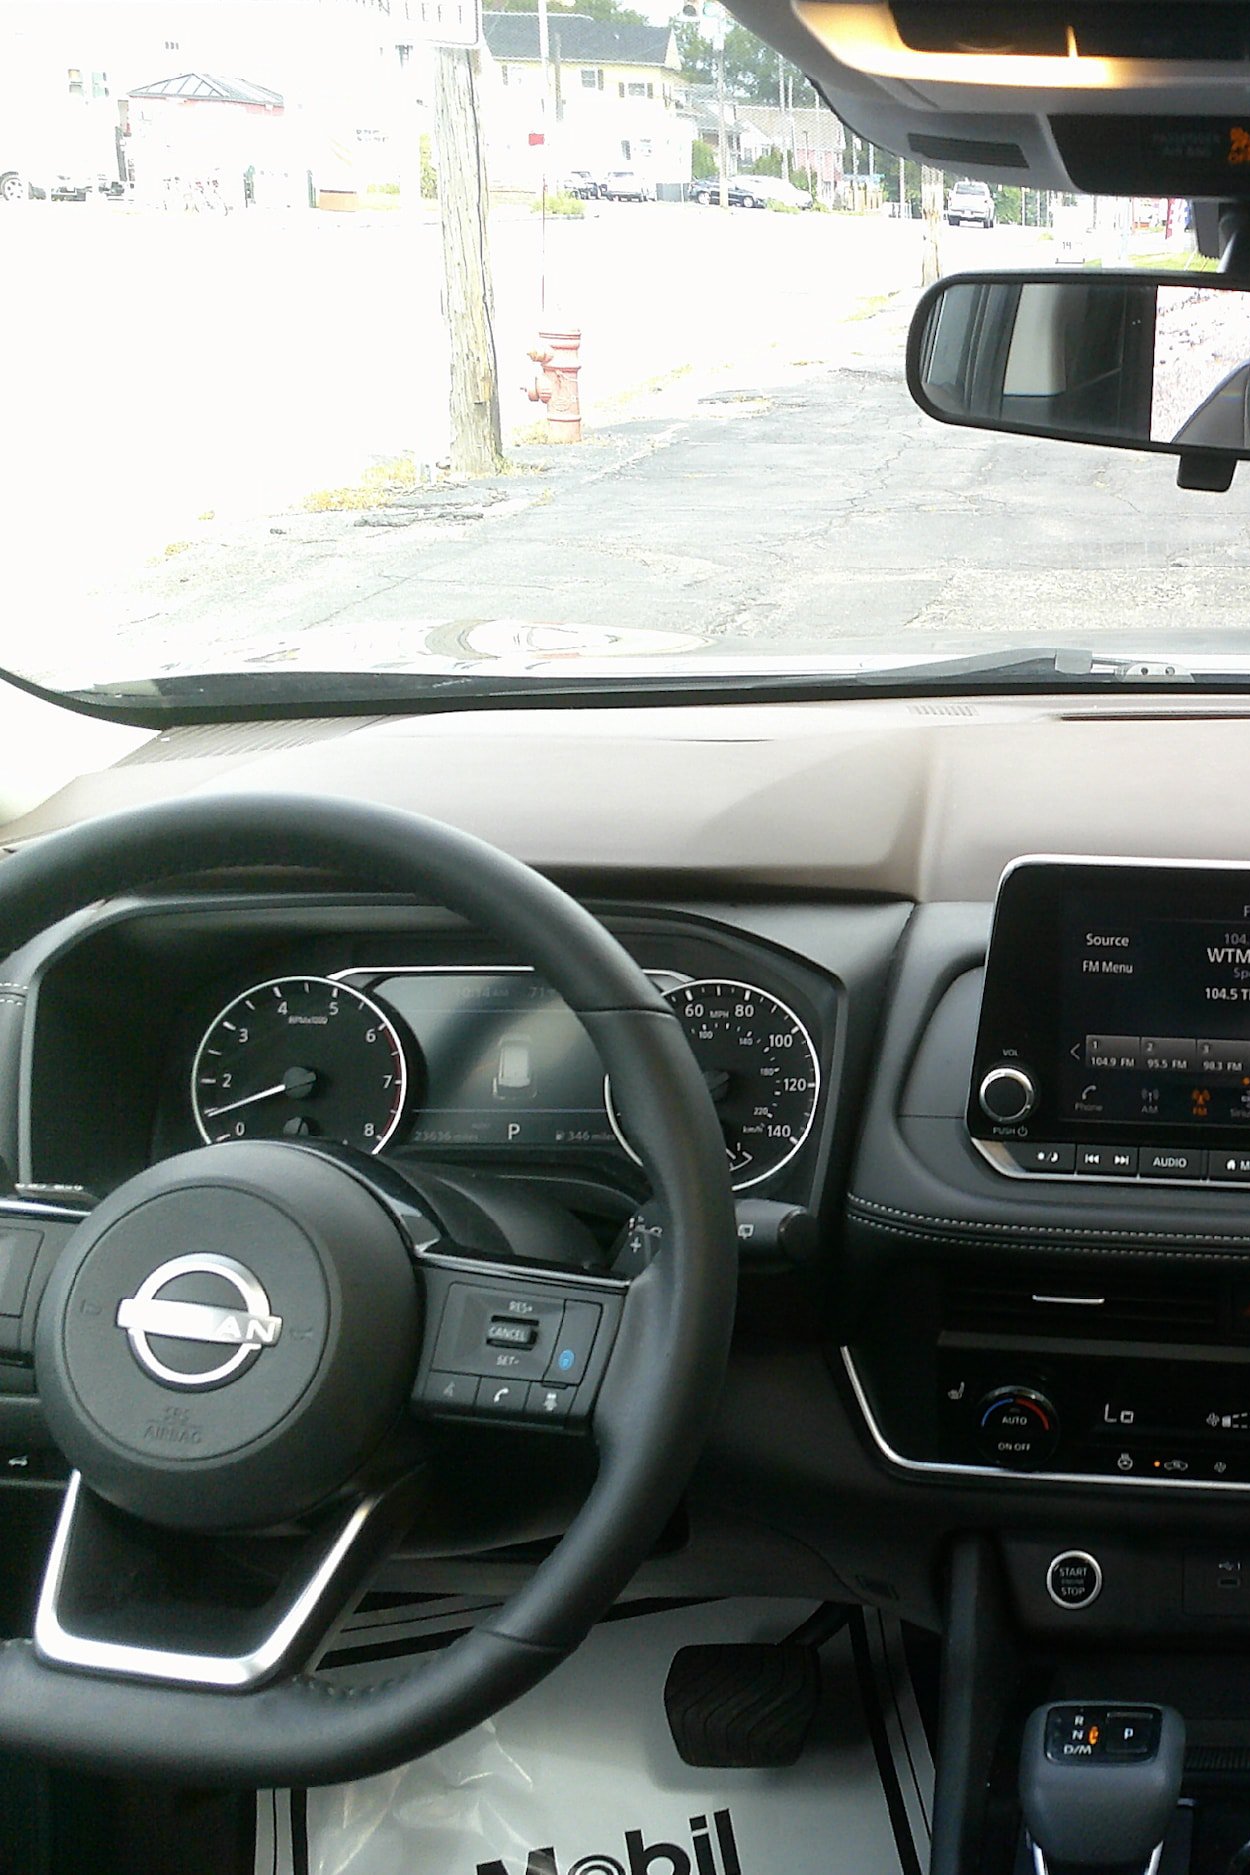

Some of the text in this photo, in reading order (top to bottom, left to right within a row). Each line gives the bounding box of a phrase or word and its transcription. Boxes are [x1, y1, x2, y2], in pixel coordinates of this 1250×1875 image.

[1085, 933, 1130, 948] Source
[1082, 960, 1133, 974] FM Menu
[1205, 987, 1239, 1001] 104.5
[277, 1001, 289, 1016] 4
[329, 1001, 339, 1016] 5
[684, 1003, 704, 1018] 60
[734, 1003, 755, 1018] 80
[239, 1028, 249, 1043] 3
[365, 1028, 376, 1043] 6
[769, 1033, 793, 1048] 100
[1120, 1057, 1135, 1067] FM
[1172, 1060, 1187, 1069] FM
[1227, 1062, 1242, 1071] FM
[222, 1074, 232, 1088] 2
[383, 1074, 393, 1089] 7
[783, 1078, 807, 1092] 120
[236, 1122, 245, 1136] 0
[364, 1122, 375, 1137] 8
[507, 1123, 521, 1140] P
[767, 1124, 791, 1138] 140
[1152, 1157, 1187, 1168] AUDIO
[1104, 1402, 1134, 1424] Lo
[1002, 1416, 1028, 1426] AUTO
[1060, 1567, 1087, 1577] START
[1061, 1587, 1086, 1596] STOP
[1074, 1715, 1084, 1726] R
[1072, 1730, 1084, 1740] N
[1123, 1727, 1134, 1740] P
[1063, 1744, 1092, 1755] D/M
